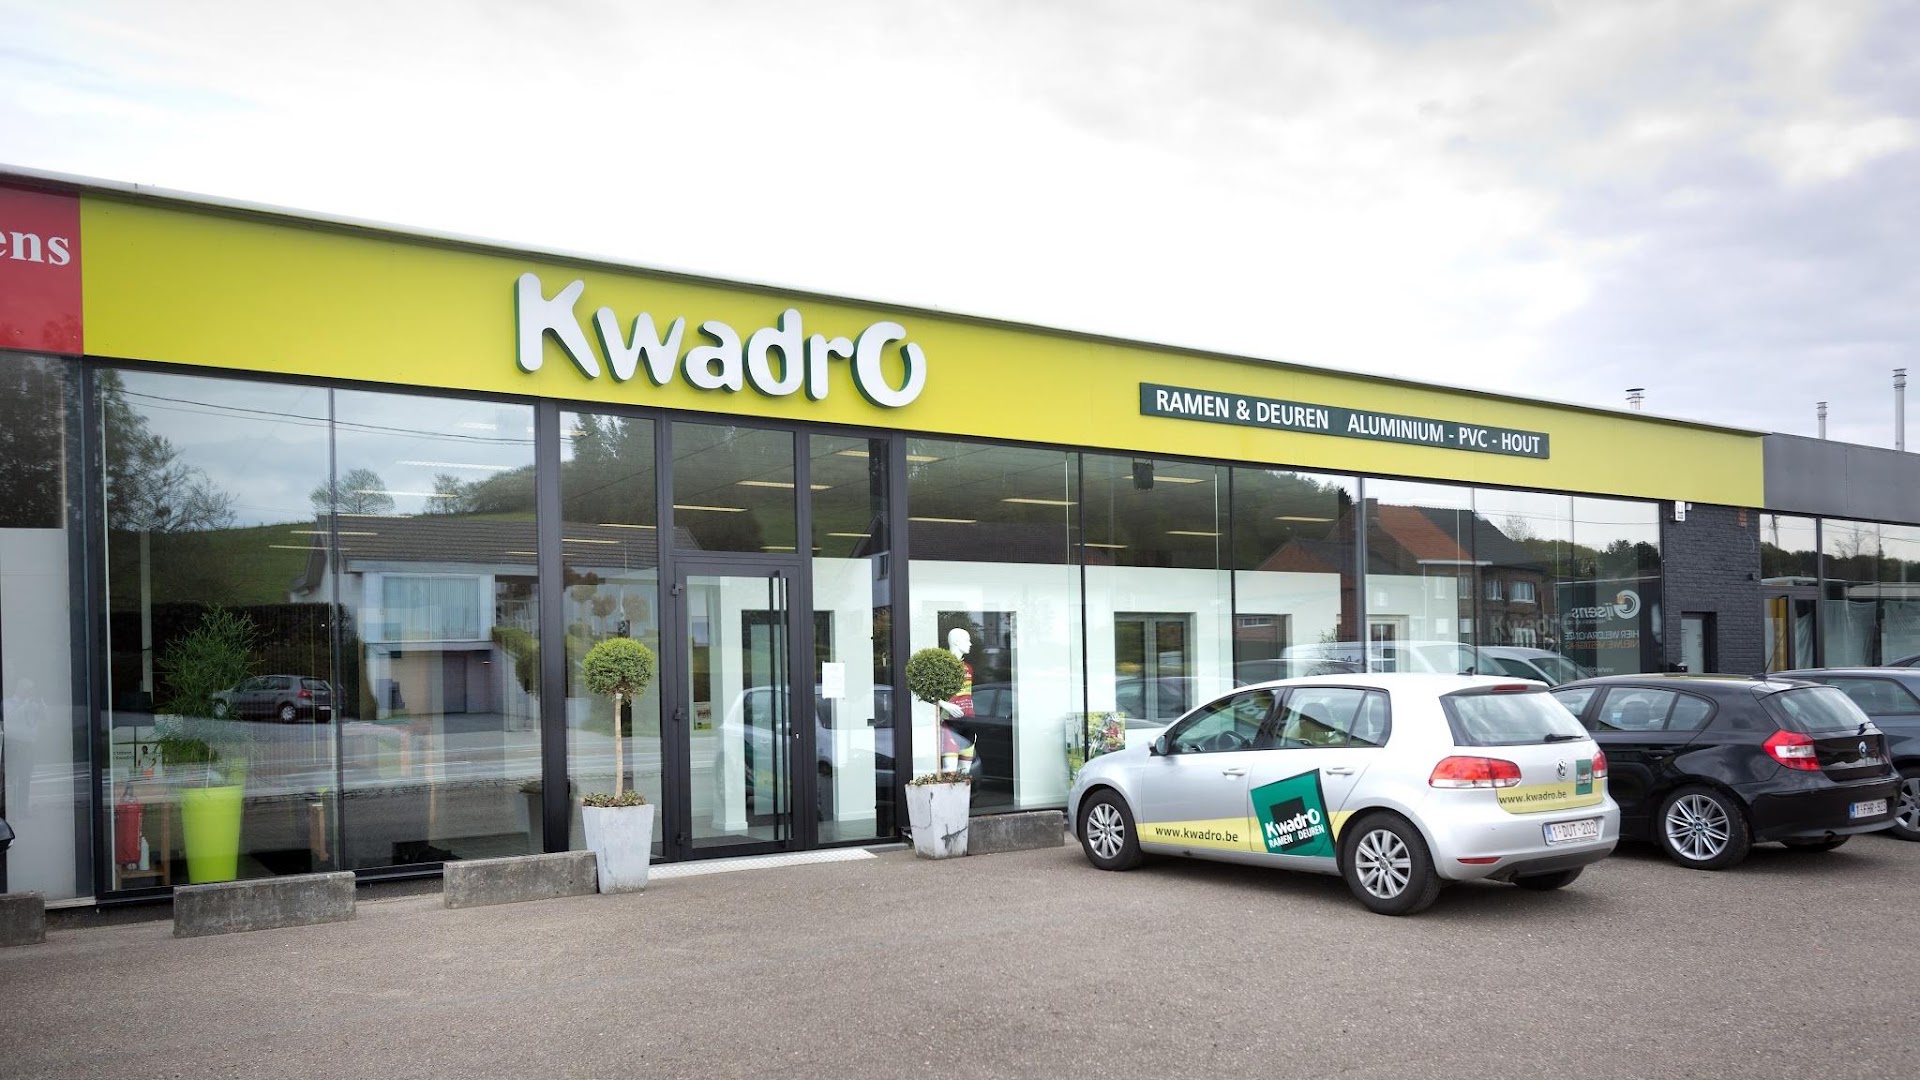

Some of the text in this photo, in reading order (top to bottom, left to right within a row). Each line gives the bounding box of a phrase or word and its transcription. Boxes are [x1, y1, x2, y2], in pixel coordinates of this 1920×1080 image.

[1156, 389, 1230, 418] RAMEN
[1236, 399, 1251, 421] &
[1256, 401, 1329, 430] DEUREN
[1347, 413, 1444, 443] ALUMINIUM
[1458, 427, 1488, 449] PVC
[1501, 433, 1541, 455] HOUT
[1499, 790, 1567, 804] www.kwadro.be
[1155, 827, 1239, 842] www.kwadro.be
[1268, 824, 1325, 849] RAMEN DEUREN
